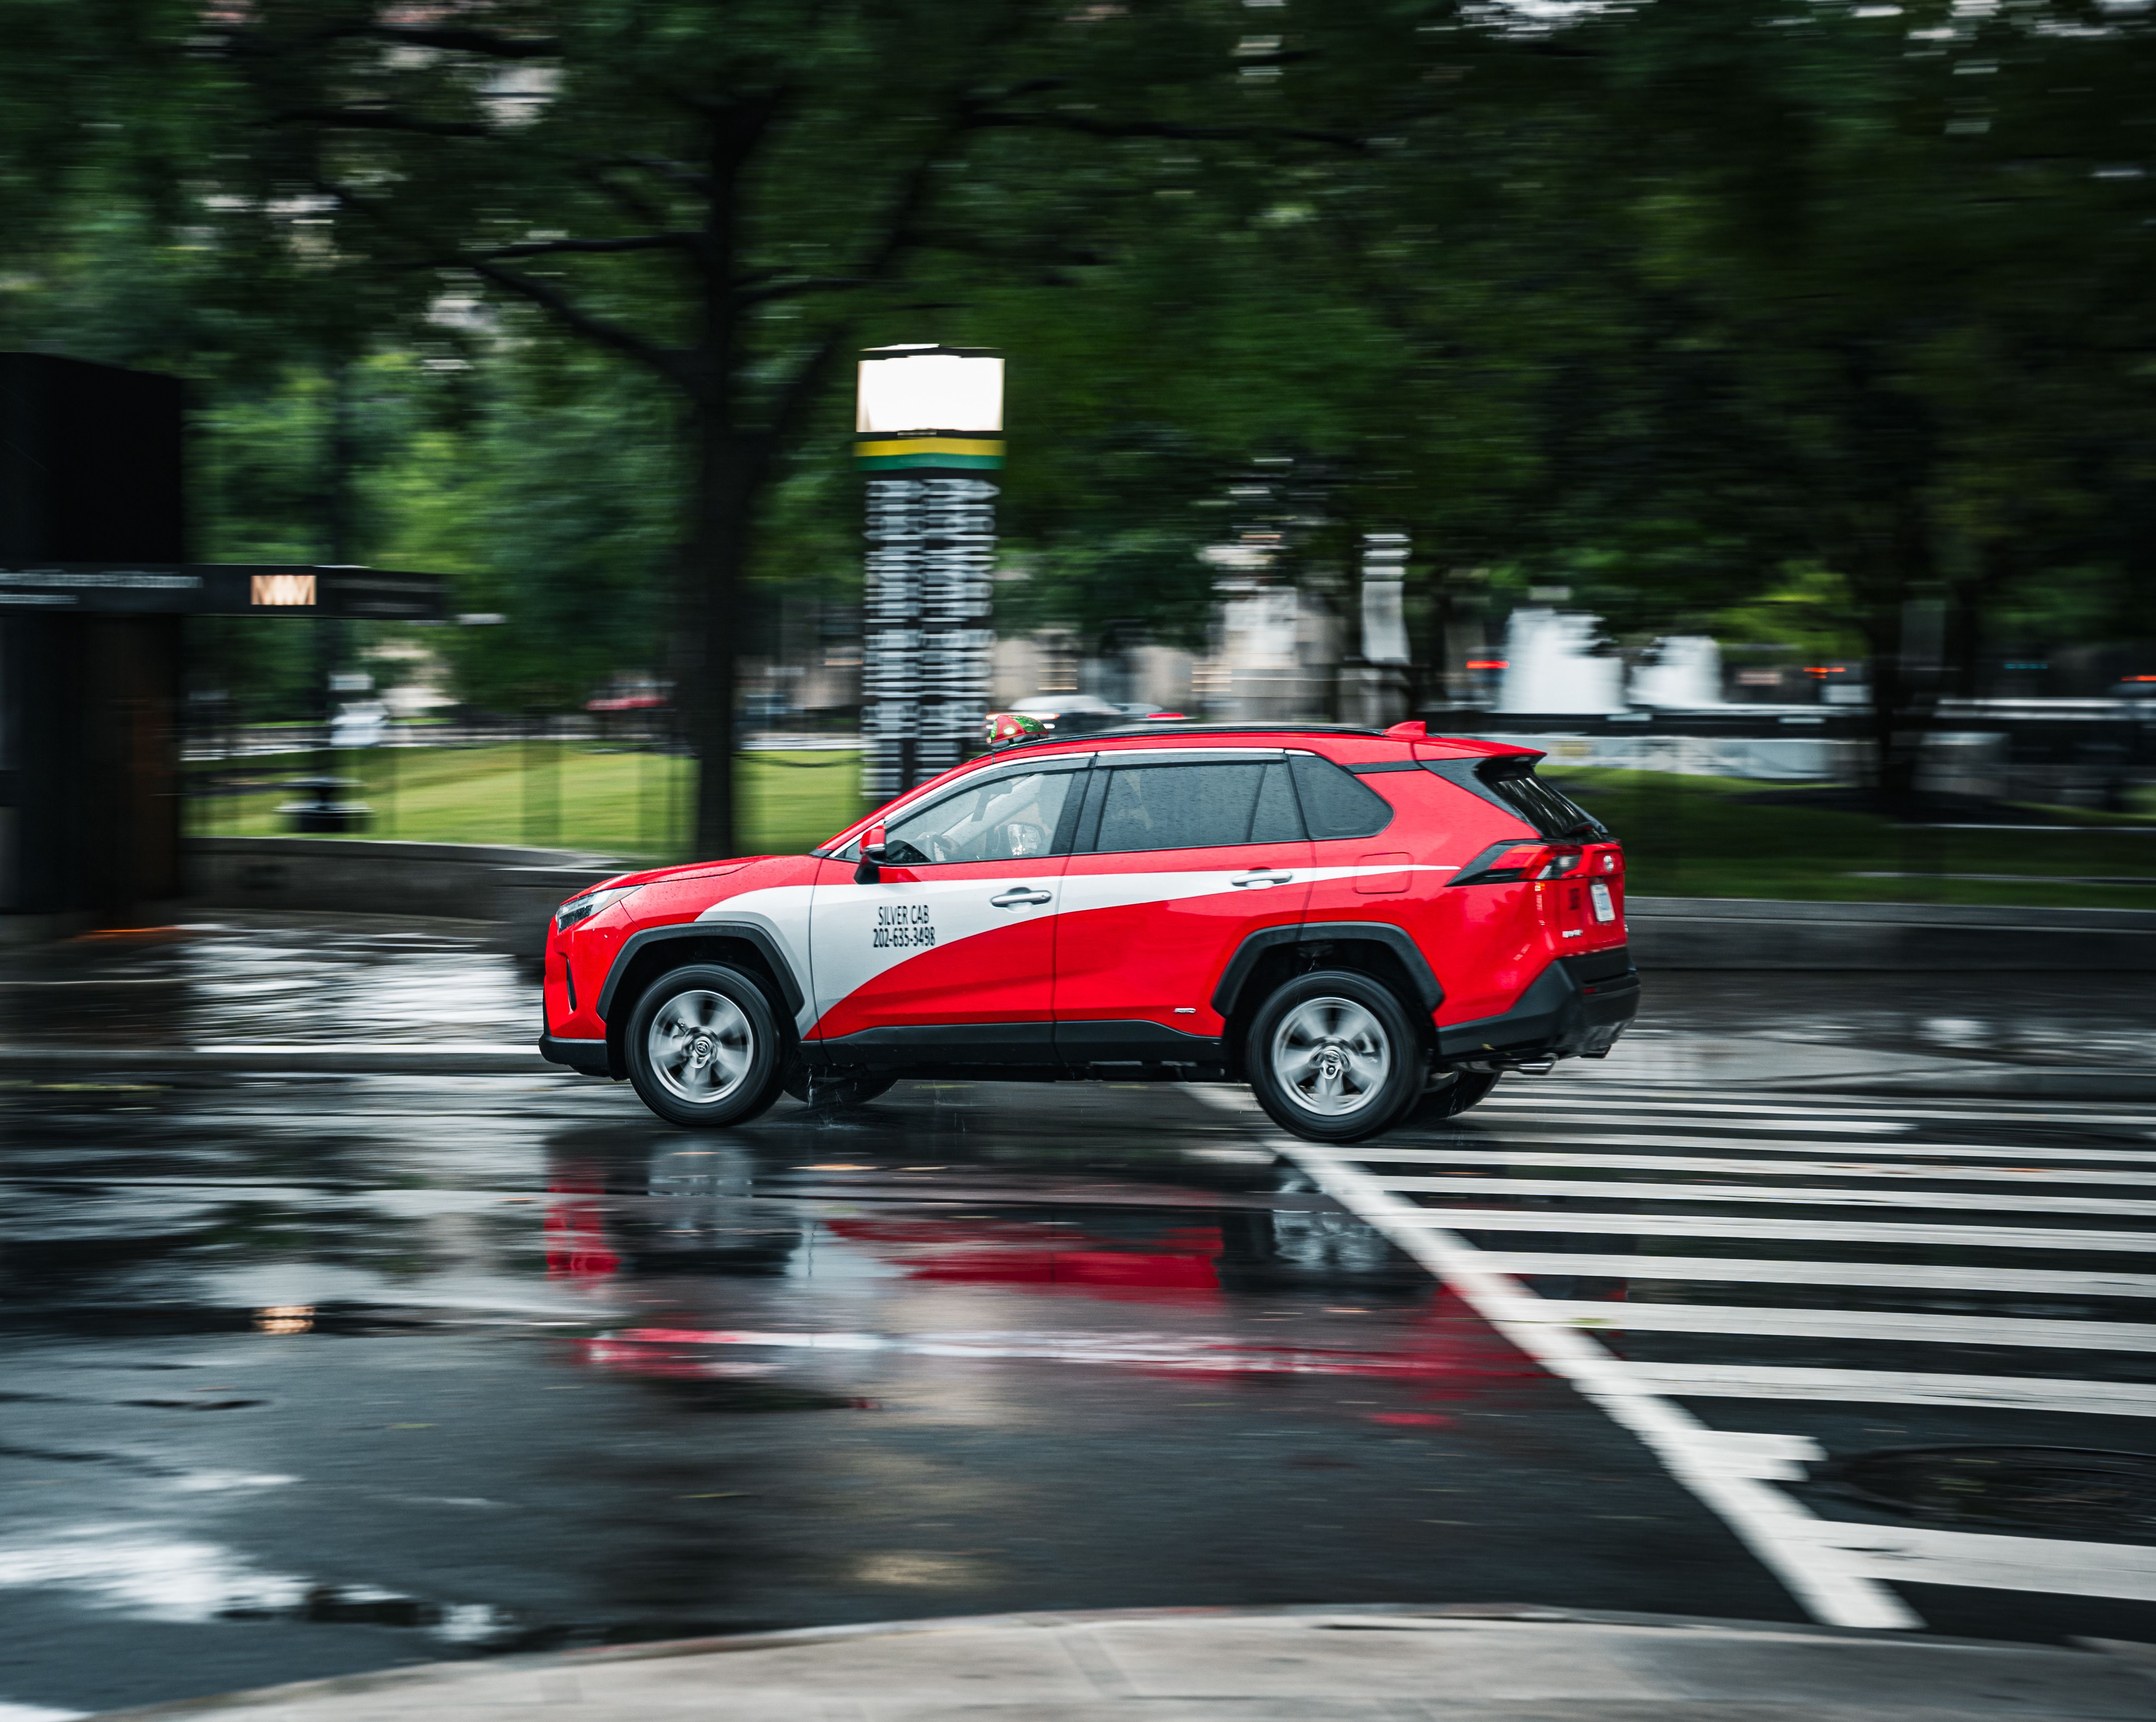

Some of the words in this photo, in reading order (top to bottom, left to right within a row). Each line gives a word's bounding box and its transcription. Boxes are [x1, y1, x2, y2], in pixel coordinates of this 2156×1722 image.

[878, 905, 908, 925] SILVER
[911, 905, 929, 924] CAB
[873, 926, 935, 947] 202-635-3498
